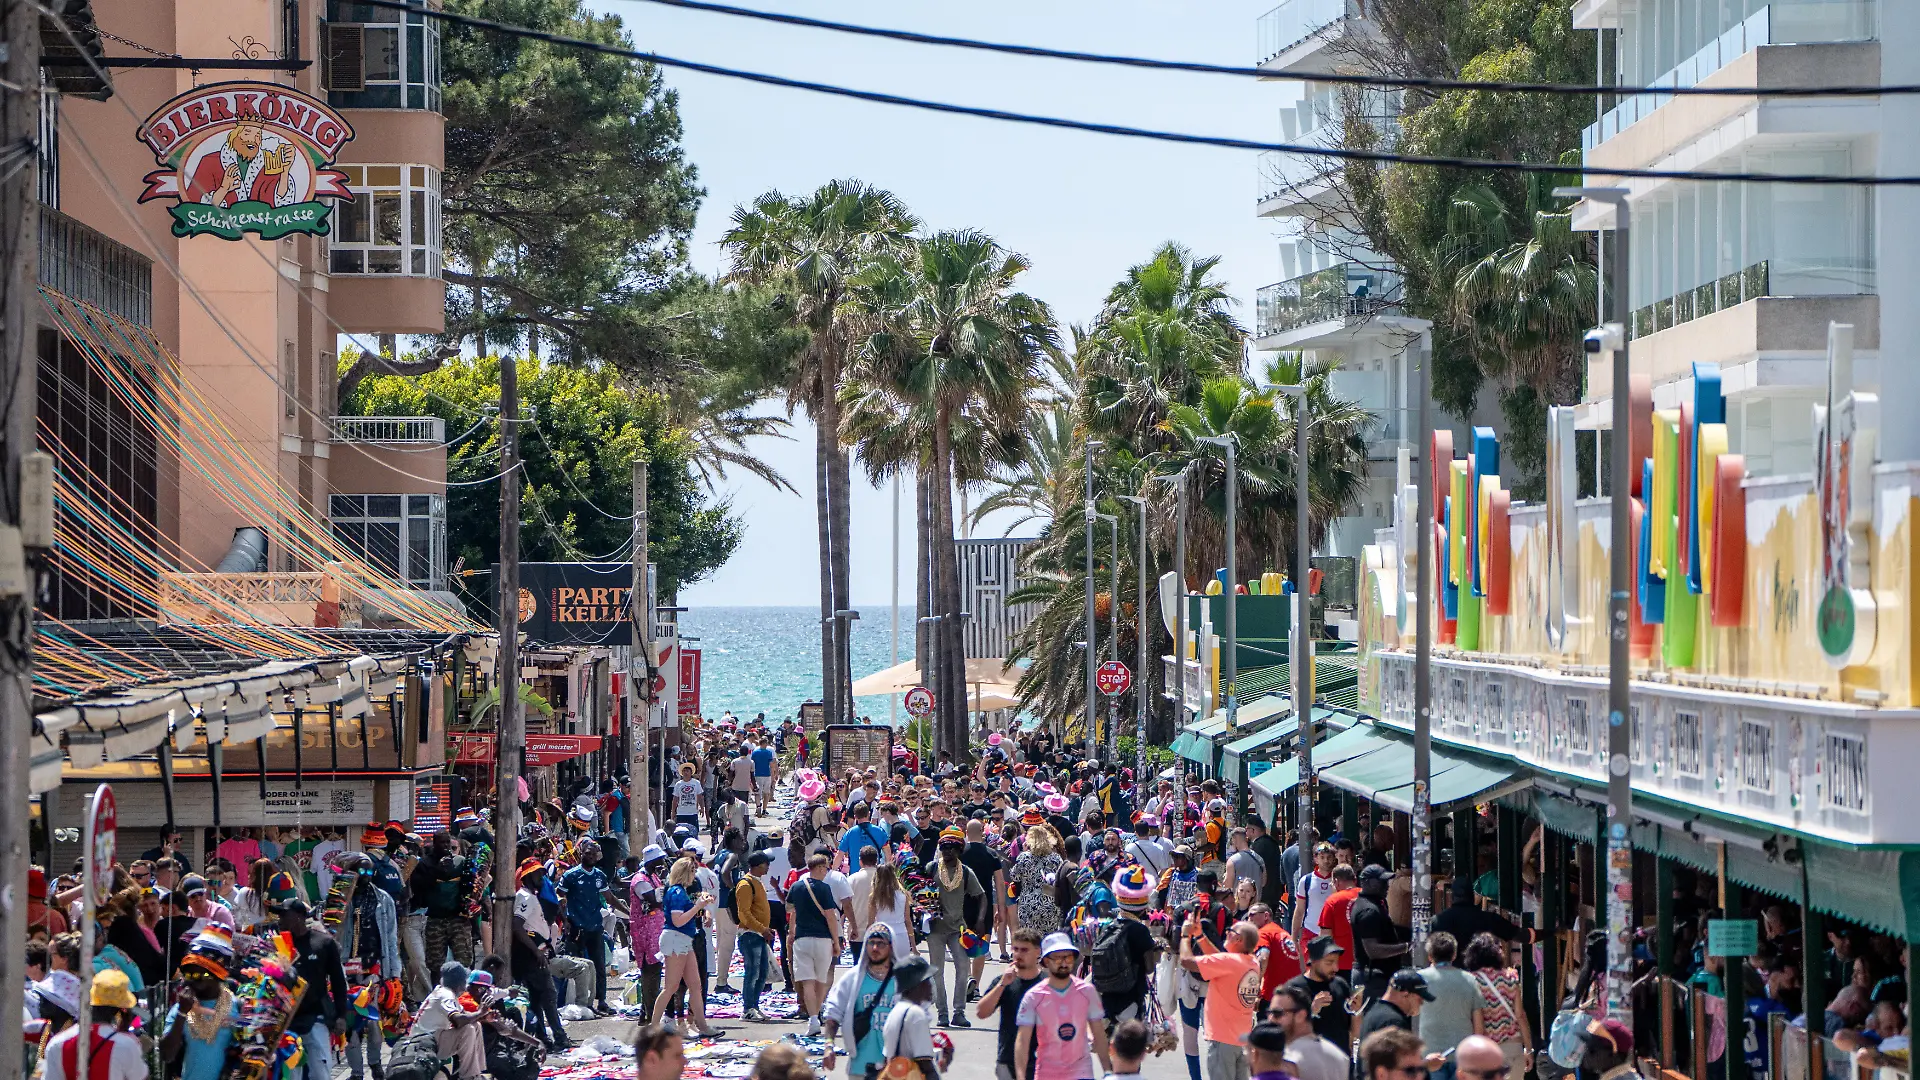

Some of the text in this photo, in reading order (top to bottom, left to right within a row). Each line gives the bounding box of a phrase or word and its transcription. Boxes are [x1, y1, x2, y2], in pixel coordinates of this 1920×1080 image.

[153, 91, 342, 148] BIERKÖNIG
[187, 208, 315, 230] Schinkenstrasse
[655, 625, 674, 638] CLUB
[1100, 674, 1127, 684] STOP
[301, 727, 385, 750] SHOP
[532, 743, 547, 751] grill
